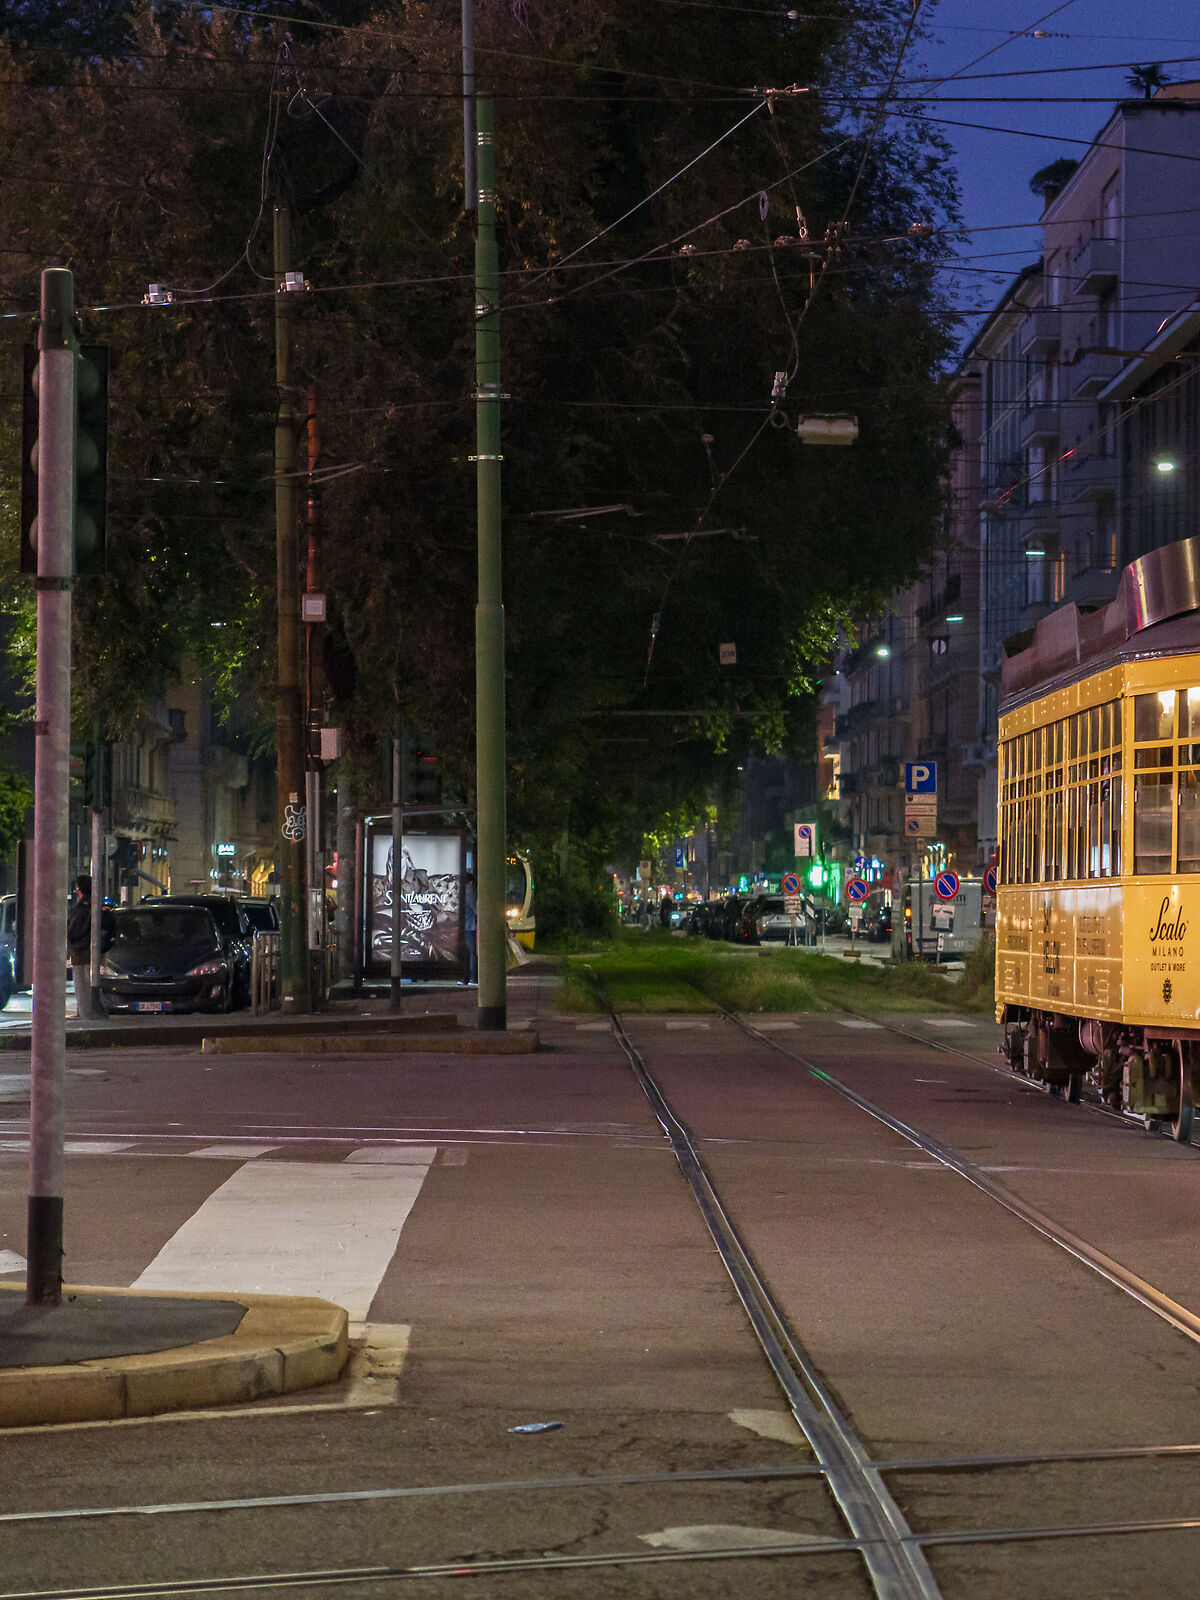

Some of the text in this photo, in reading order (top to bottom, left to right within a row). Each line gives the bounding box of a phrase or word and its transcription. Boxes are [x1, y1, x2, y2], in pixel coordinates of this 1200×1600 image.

[912, 765, 930, 790] P
[384, 890, 412, 906] SNT
[1149, 896, 1187, 942] Scalo
[1152, 946, 1184, 957] MILANO
[1150, 963, 1167, 971] OUTLET
[1173, 963, 1186, 972] MORE
